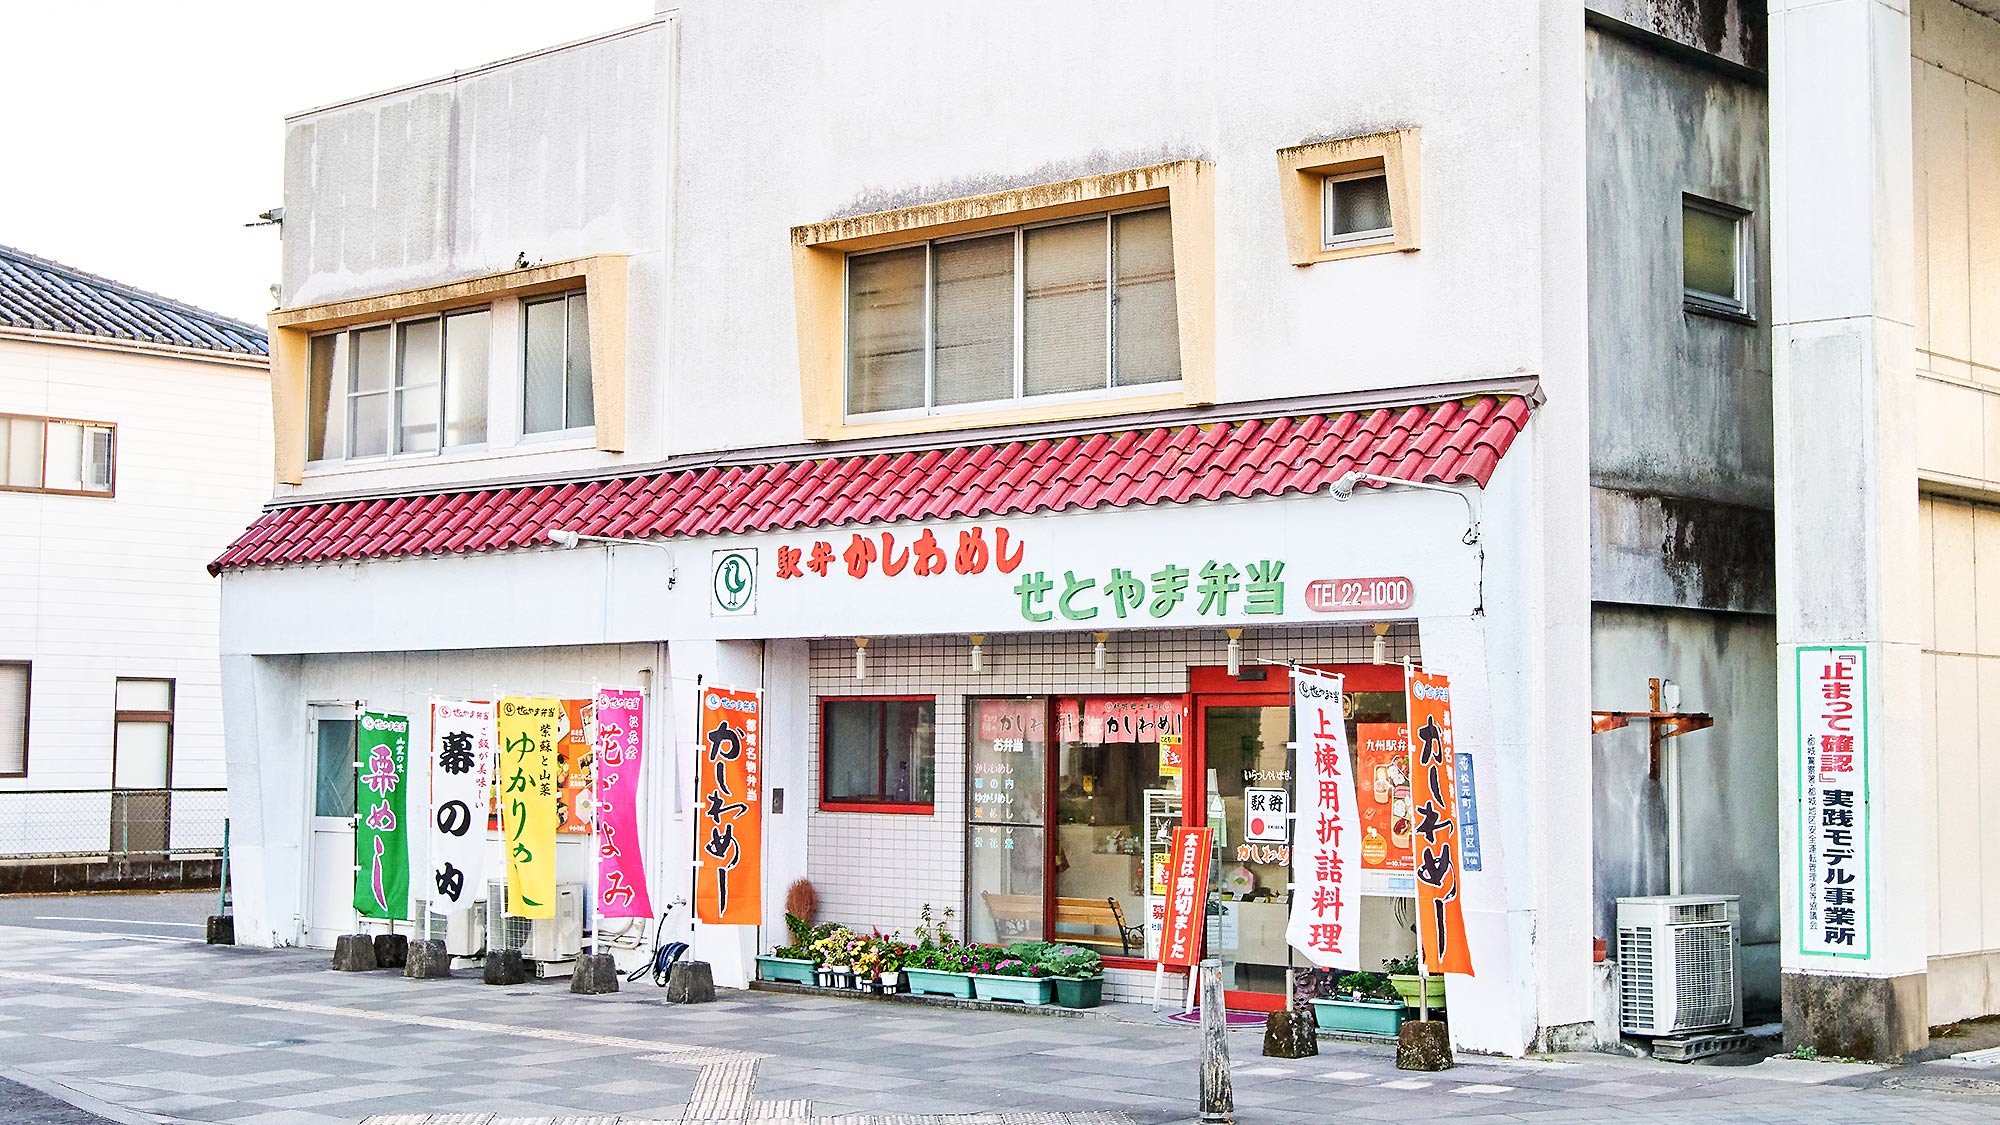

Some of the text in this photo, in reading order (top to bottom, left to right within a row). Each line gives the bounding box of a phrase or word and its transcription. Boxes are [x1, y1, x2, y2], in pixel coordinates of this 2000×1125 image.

[777, 526, 1025, 580] 駅弁 かしわめし
[1013, 559, 1286, 622] せとやま弁当
[475, 726, 489, 809] ご飯が美味しい
[539, 723, 552, 797] 紫蘇と山菜
[993, 738, 1024, 753] お弁当
[1366, 738, 1407, 752] 九州駅弁
[360, 744, 399, 911] 栗めし
[436, 730, 475, 902] 幕の内
[705, 720, 748, 919] かしわめし
[974, 792, 1014, 805] ゆかりめし
[1307, 707, 1344, 954] 上棟用折詰料理
[1458, 773, 1477, 848] 松元町1街区
[1415, 714, 1458, 963] かしわめし
[1170, 832, 1200, 960] 本日は売切ました
